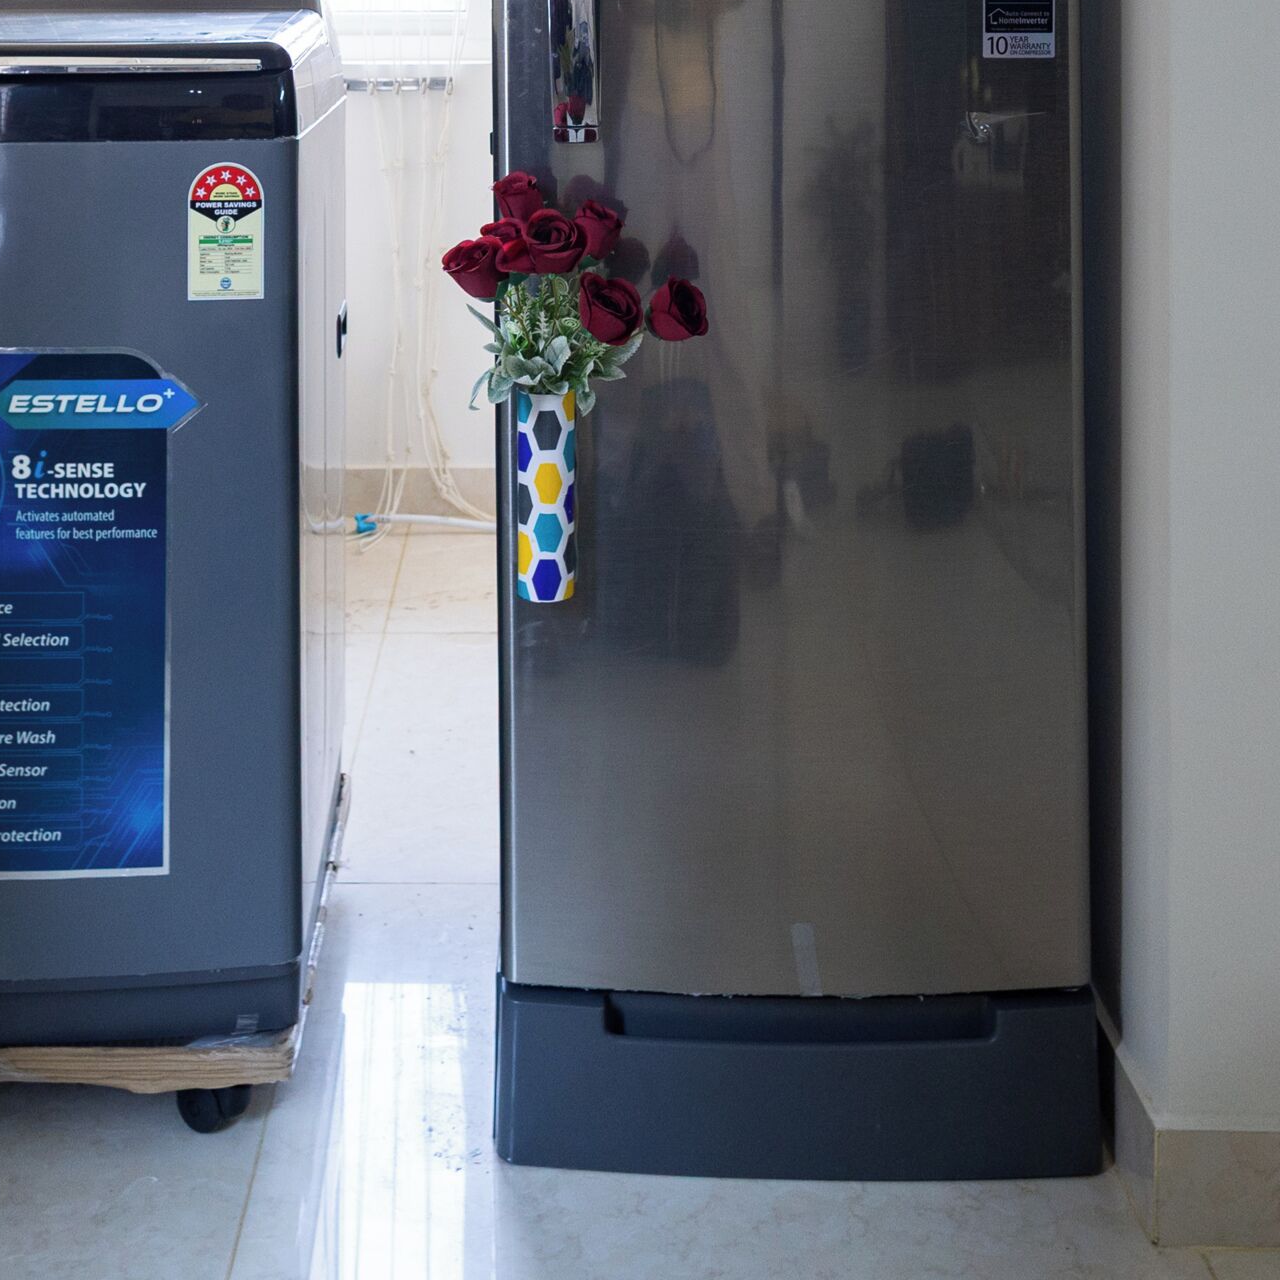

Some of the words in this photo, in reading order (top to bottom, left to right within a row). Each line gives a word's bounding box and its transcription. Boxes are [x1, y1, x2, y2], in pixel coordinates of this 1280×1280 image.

[987, 36, 1008, 55] 10
[11, 454, 32, 480] 8
[14, 482, 147, 500] TECHNOLOGY
[15, 509, 60, 523] Activates
[61, 509, 115, 522] automated
[15, 527, 56, 540] features
[56, 527, 71, 540] for
[72, 526, 94, 540] best
[95, 526, 158, 542] performance
[3, 632, 69, 647] Selection
[16, 730, 56, 744] Wash
